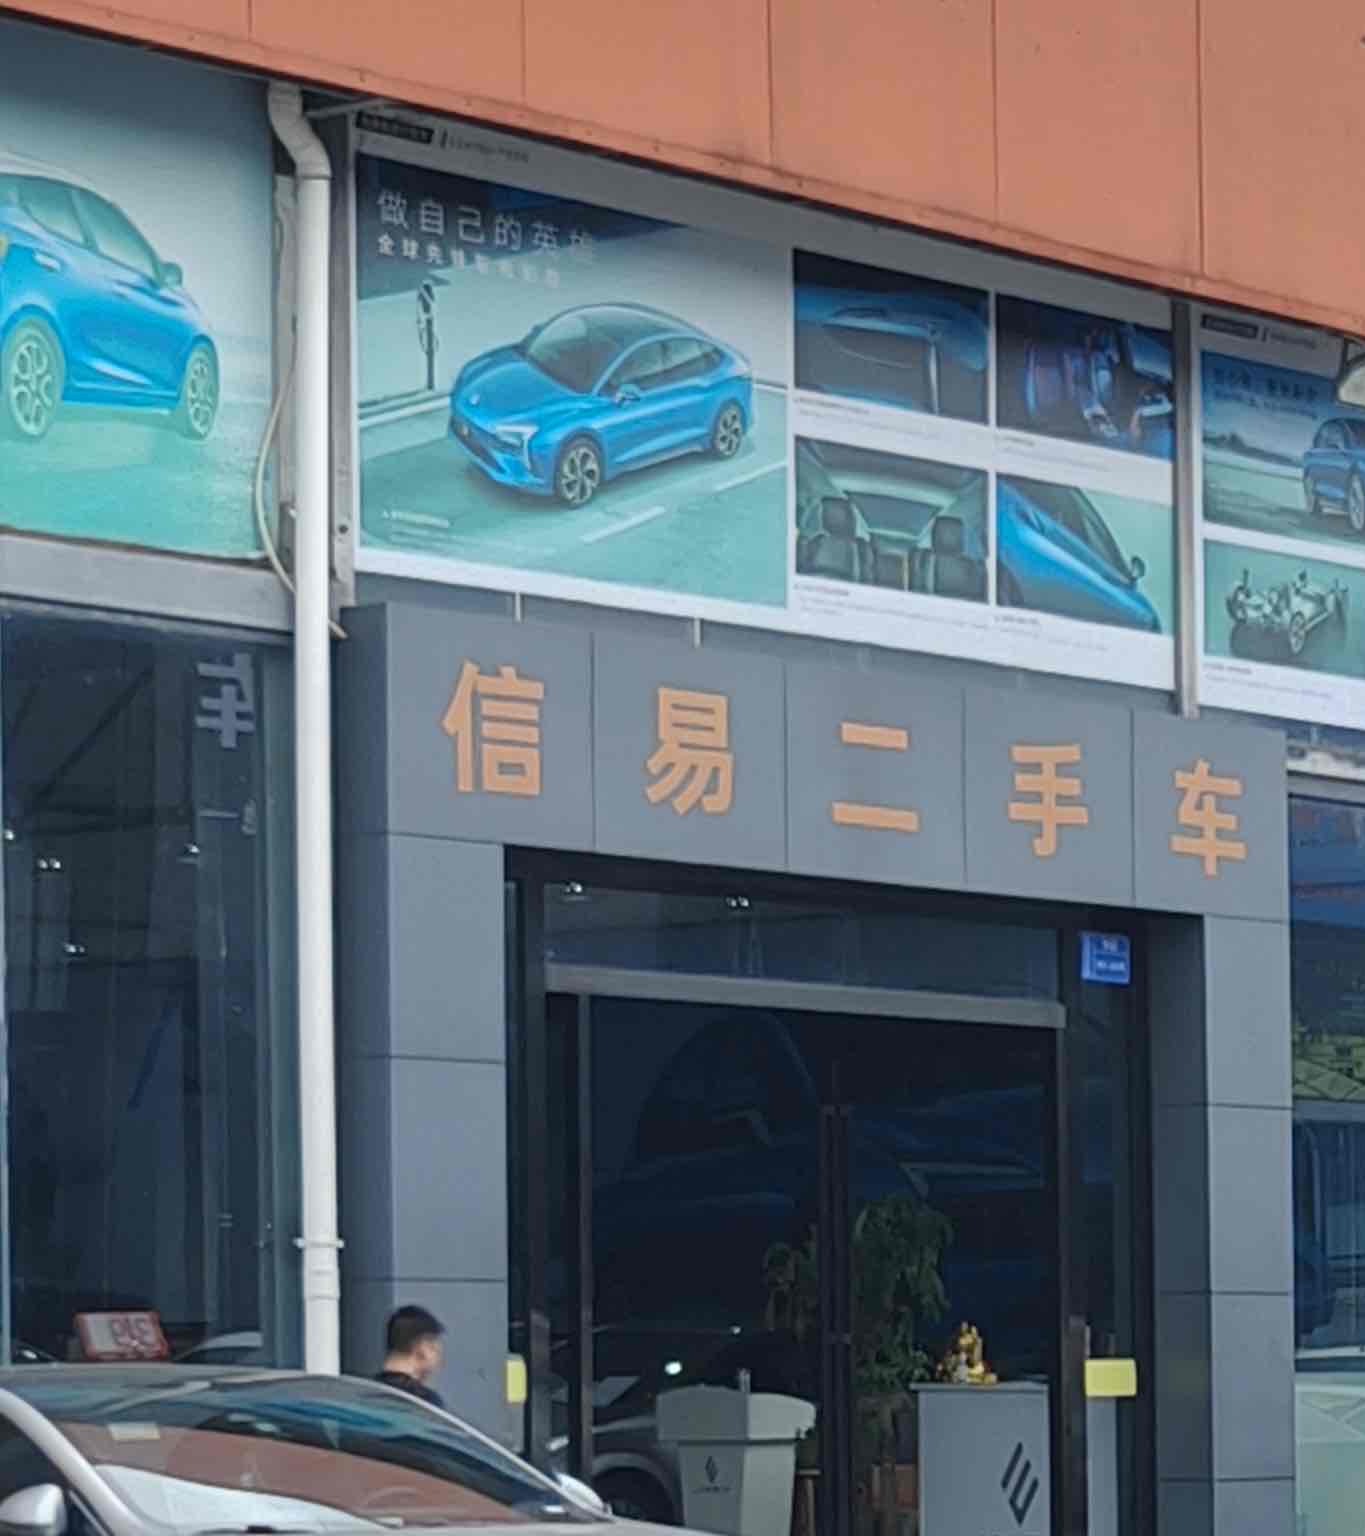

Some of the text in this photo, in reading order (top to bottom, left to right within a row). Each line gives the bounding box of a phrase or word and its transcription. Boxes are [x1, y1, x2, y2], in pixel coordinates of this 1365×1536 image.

[442, 660, 1247, 877] 信易二手车
